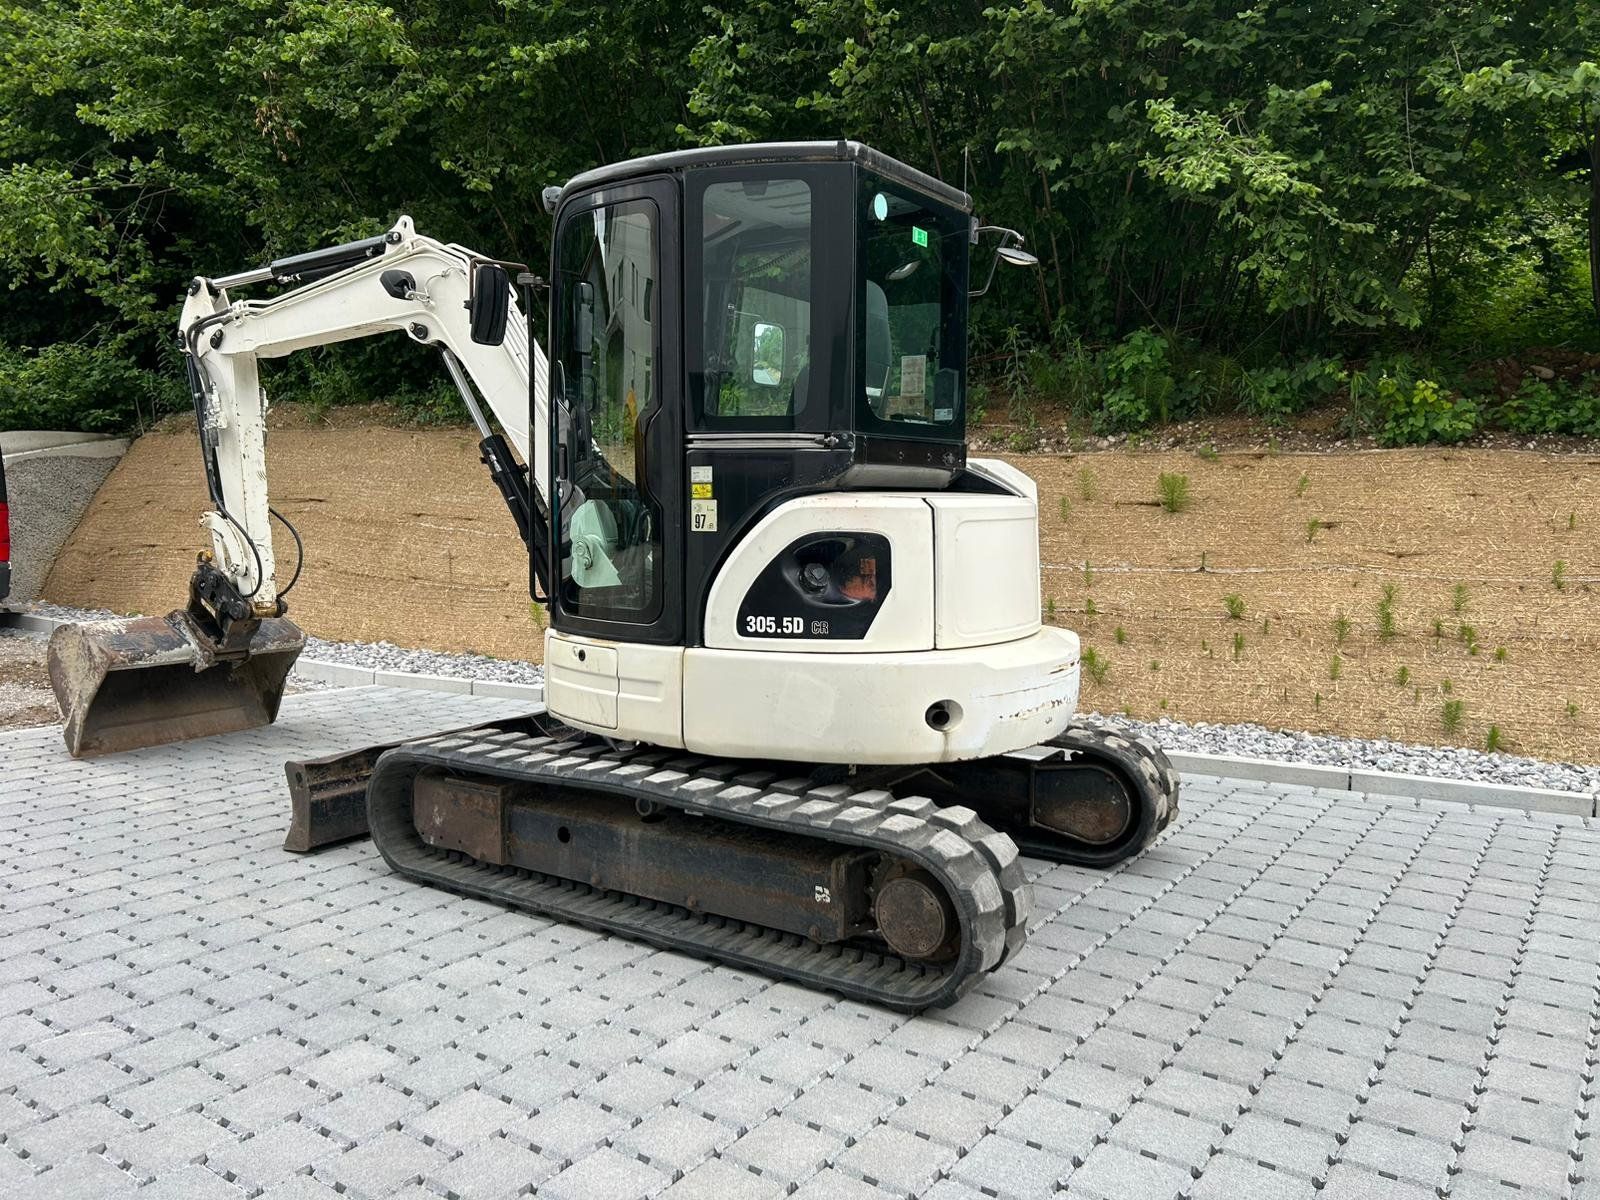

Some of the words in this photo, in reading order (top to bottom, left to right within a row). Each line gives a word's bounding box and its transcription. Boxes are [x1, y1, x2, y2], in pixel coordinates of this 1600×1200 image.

[695, 513, 707, 529] 97
[746, 615, 804, 634] 305.5D
[811, 620, 829, 635] CR
